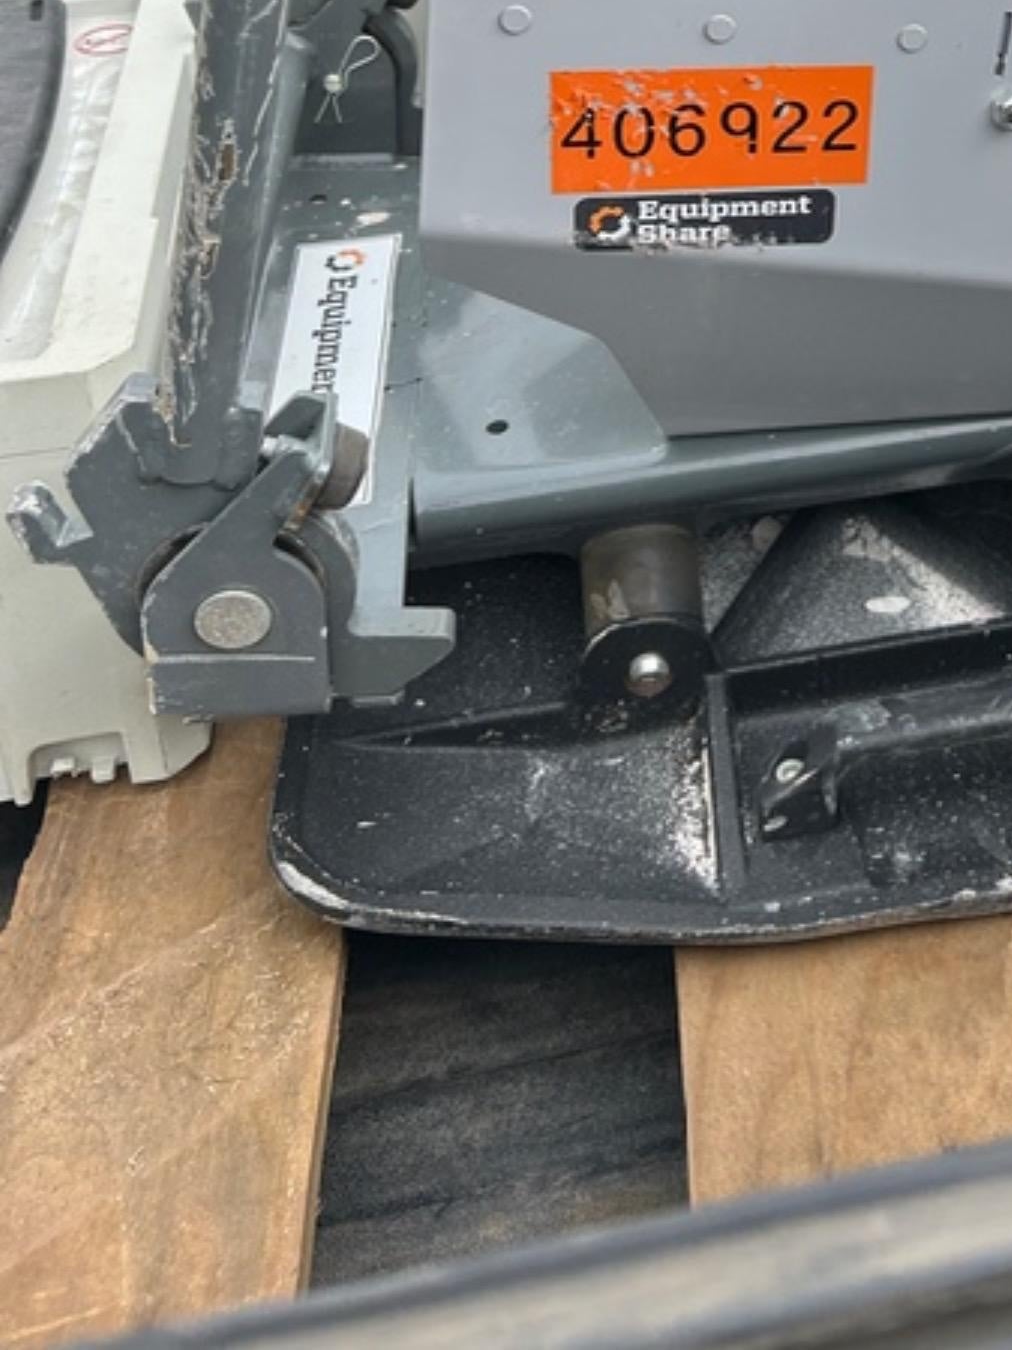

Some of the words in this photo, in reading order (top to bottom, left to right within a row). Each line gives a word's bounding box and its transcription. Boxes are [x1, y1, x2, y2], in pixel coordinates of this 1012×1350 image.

[561, 99, 859, 159] 406922
[638, 196, 812, 222] Equipment
[637, 223, 733, 244] Share
